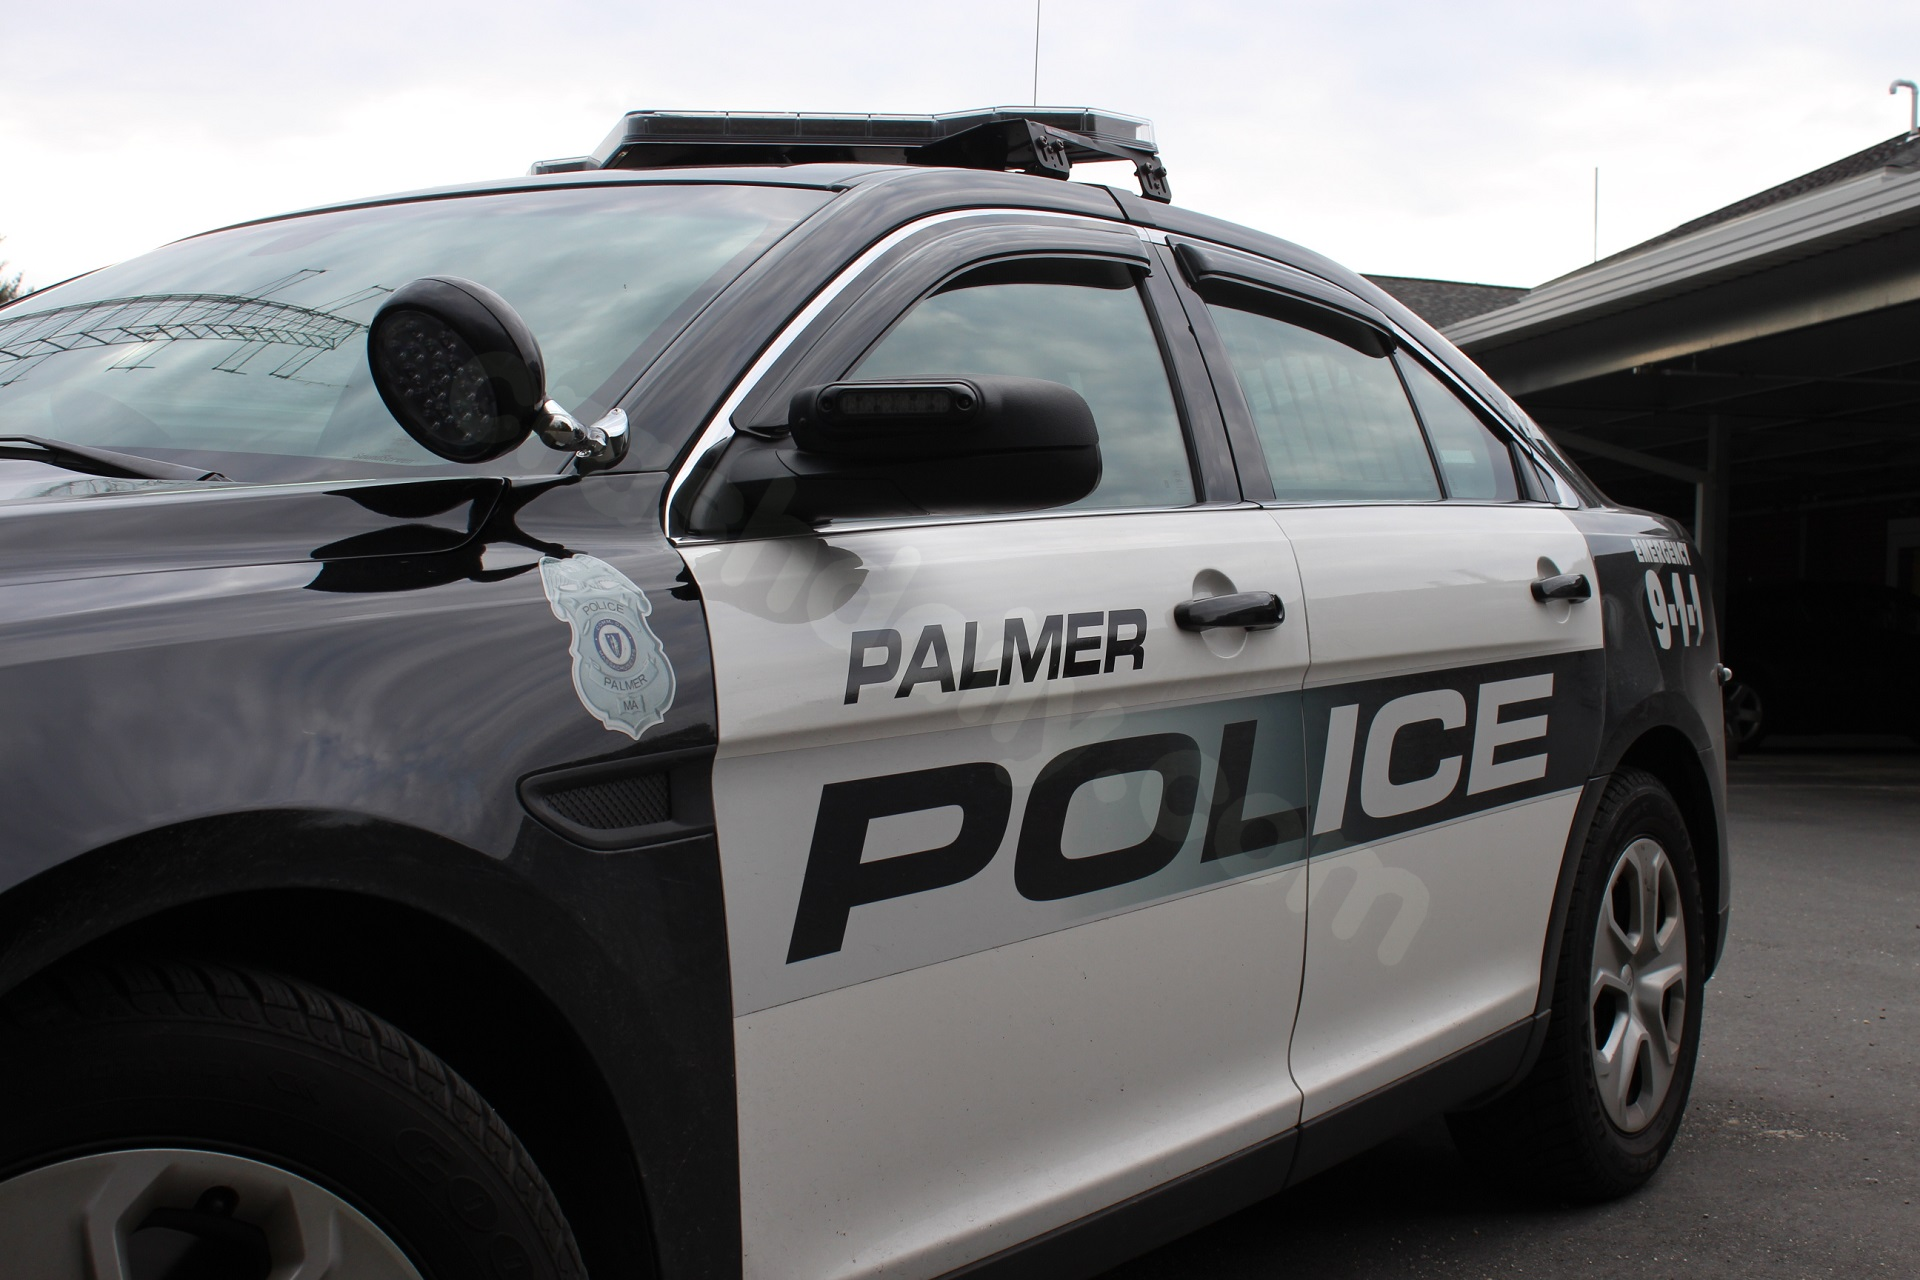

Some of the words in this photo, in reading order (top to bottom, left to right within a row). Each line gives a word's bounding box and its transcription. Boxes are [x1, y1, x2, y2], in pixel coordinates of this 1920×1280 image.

[1630, 538, 1692, 566] EMERGENCY
[582, 601, 624, 615] POLICE
[1645, 569, 1704, 650] 9-1-1
[844, 608, 1147, 705] PALMER
[604, 674, 647, 691] PALMER
[623, 700, 639, 711] MA
[785, 672, 1554, 965] POLICE
